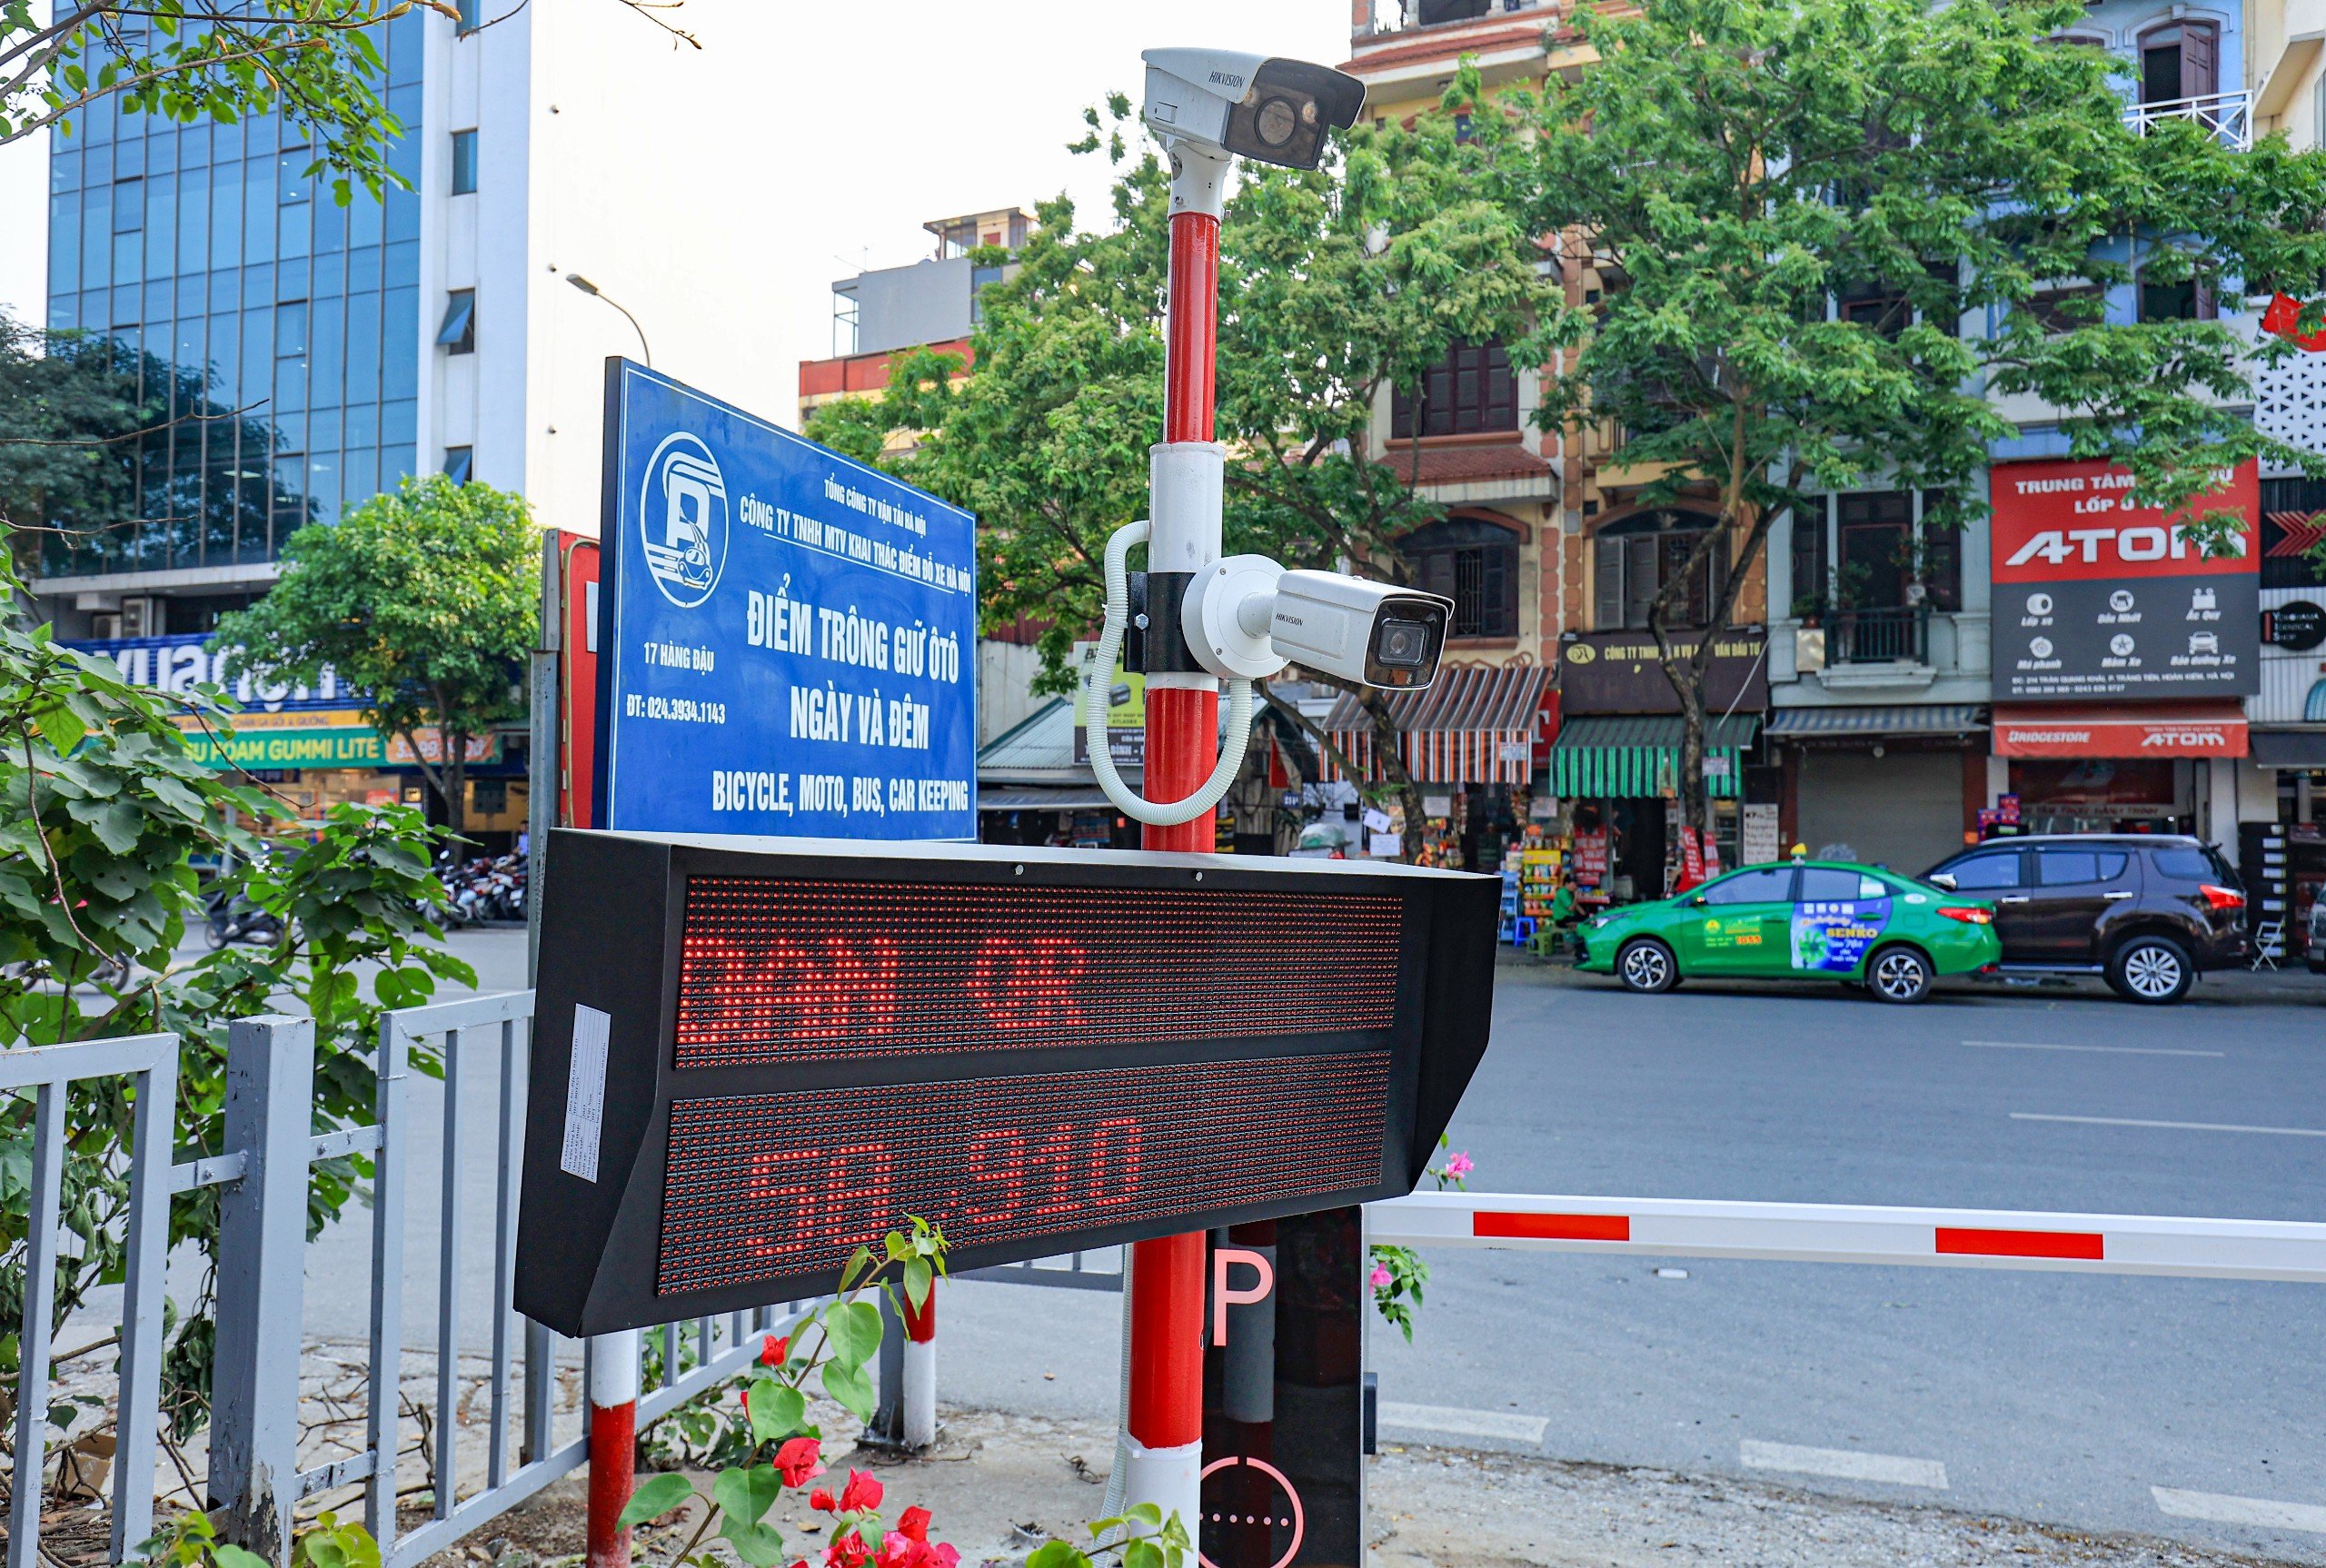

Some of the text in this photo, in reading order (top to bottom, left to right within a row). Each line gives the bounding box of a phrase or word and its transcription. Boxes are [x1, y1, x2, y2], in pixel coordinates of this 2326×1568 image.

[1208, 70, 1246, 88] HIKVISION
[2015, 477, 2084, 495] TRUNG
[2090, 472, 2135, 491] TÂM
[824, 472, 927, 539] TỔNG CÔNG TY VẬN TẢI HÀ NỘI
[2074, 495, 2114, 514] LỐP
[740, 491, 971, 597] CÔNG TY TNHH MTV KHAI THÁC ĐIỂM ĐỖ XE HÀ NỘI
[747, 572, 959, 684] ĐIỂM TRÔNG GIỮ ÔTÔ
[1276, 612, 1304, 627] HIKVISION
[643, 640, 715, 677] 17 HÀNG ĐẬU
[626, 693, 726, 725] ĐT: 024.3934.1143
[790, 680, 929, 749] NGÀY VÀ ĐÊM
[210, 740, 264, 761] FOAM
[268, 738, 334, 760] GUMMI
[337, 736, 381, 759] LITE
[2008, 729, 2091, 743] BRIDGESTONE
[2141, 732, 2225, 748] ATOM
[712, 769, 969, 818] BICYCLE, MOTO, BUS, CAR KEEPING
[1213, 1248, 1274, 1346] P
